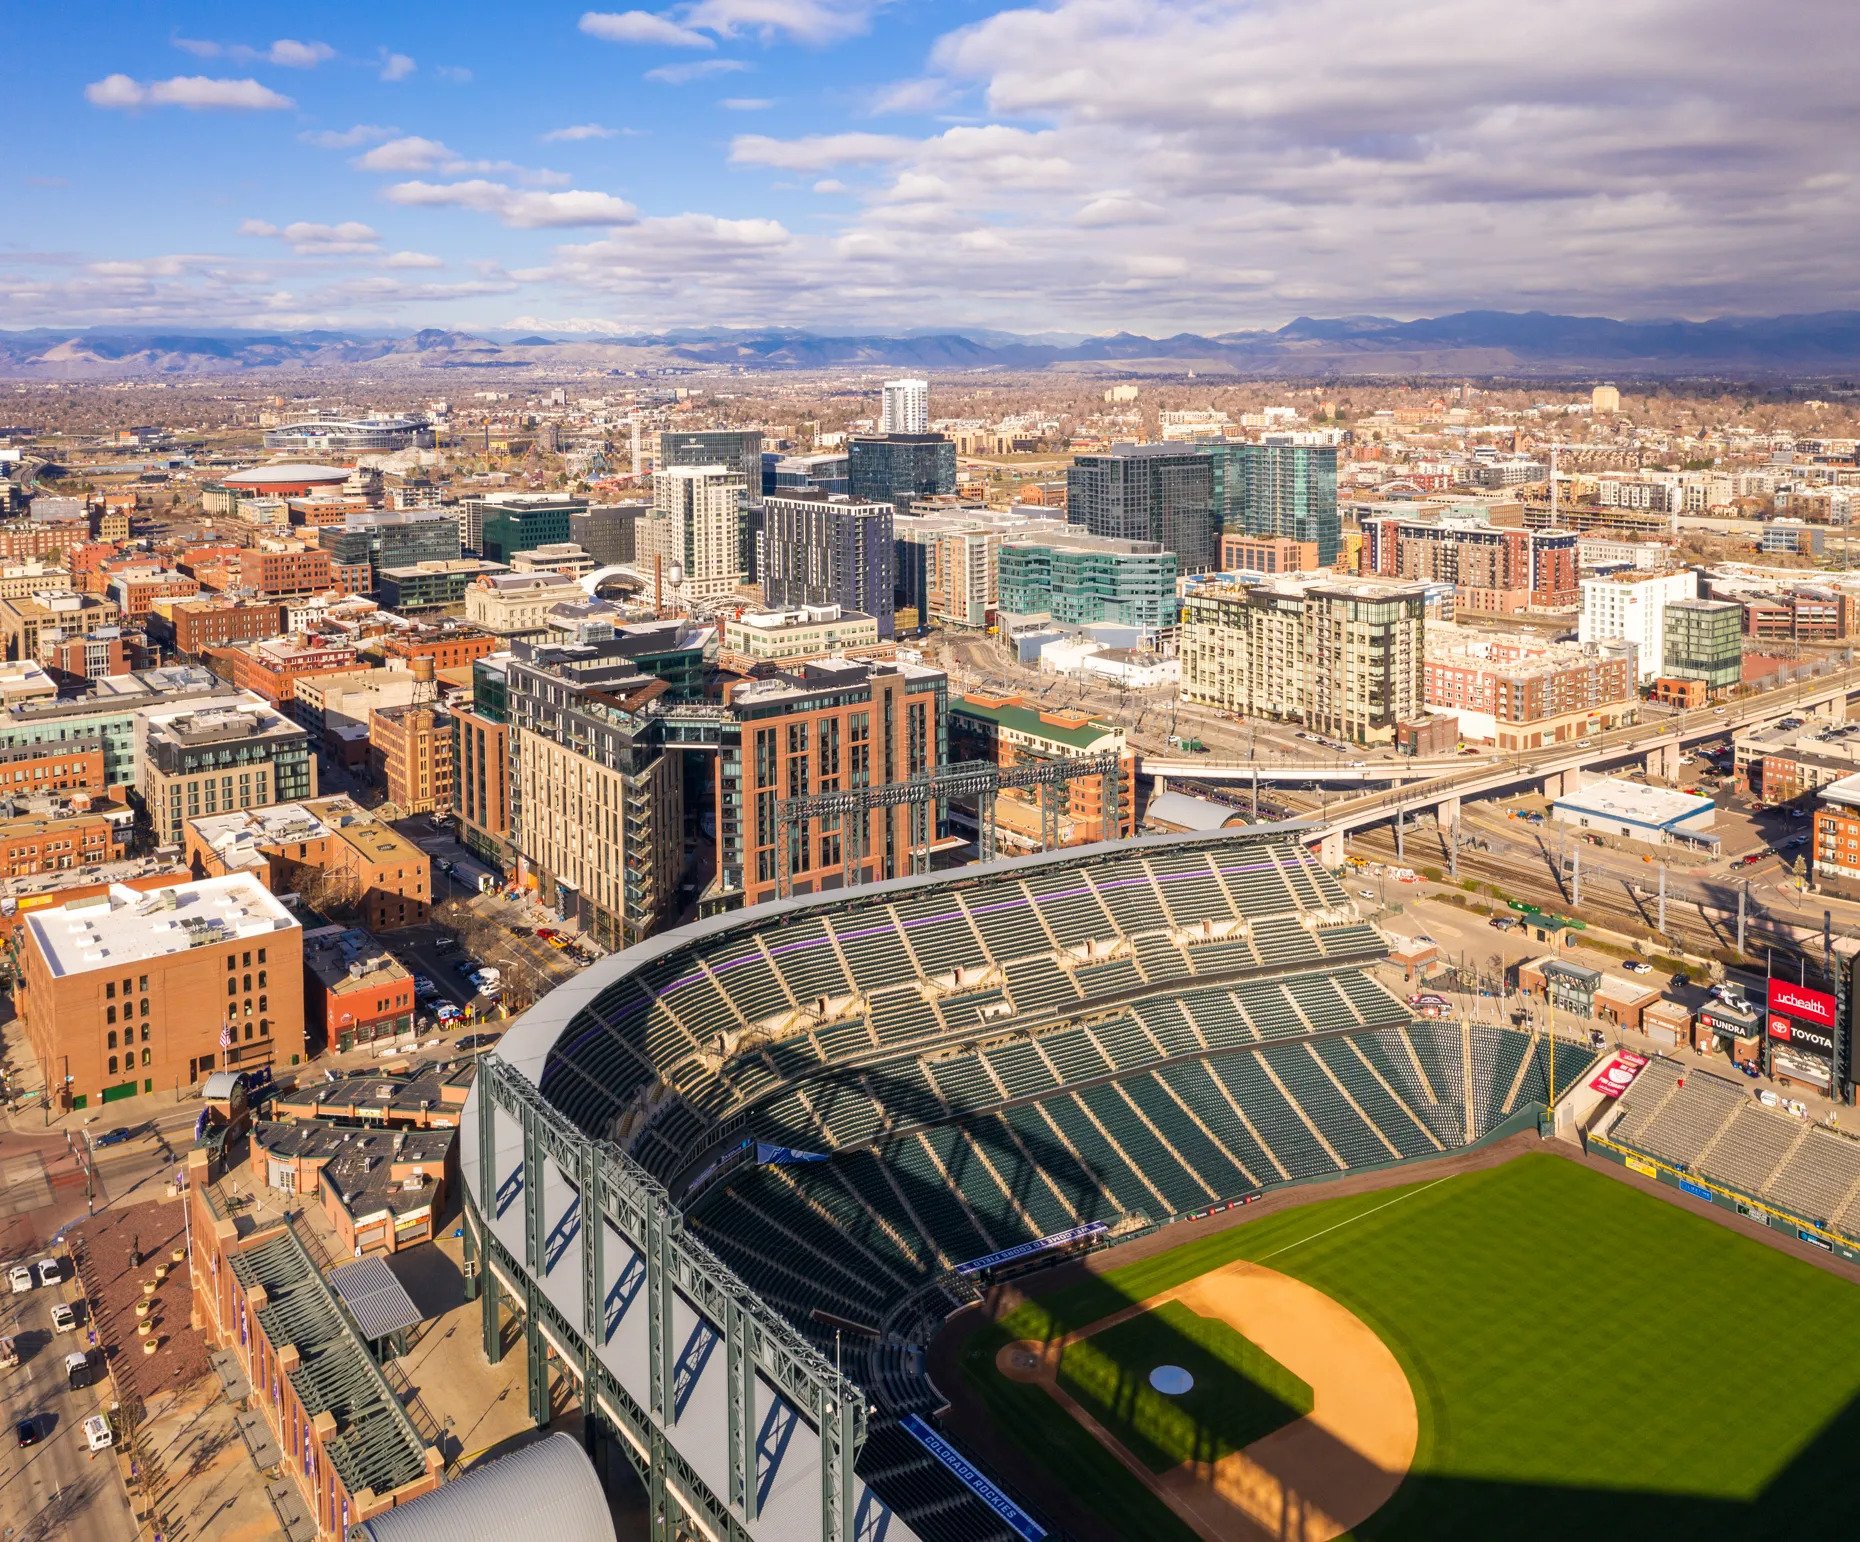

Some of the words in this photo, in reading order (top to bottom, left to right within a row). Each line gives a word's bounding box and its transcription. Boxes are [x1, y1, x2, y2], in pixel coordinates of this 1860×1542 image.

[1775, 993, 1829, 1016] uchealth
[1711, 1018, 1746, 1036] TUNDRA
[1791, 1027, 1832, 1048] TOYOTA
[1033, 1240, 1046, 1248] TO
[1046, 1227, 1090, 1244] WELCOME
[1002, 1244, 1033, 1258] COORS
[973, 1255, 1001, 1267] FIELD
[924, 1436, 973, 1480] COLORADO
[973, 1477, 1017, 1519] ROCKIES
